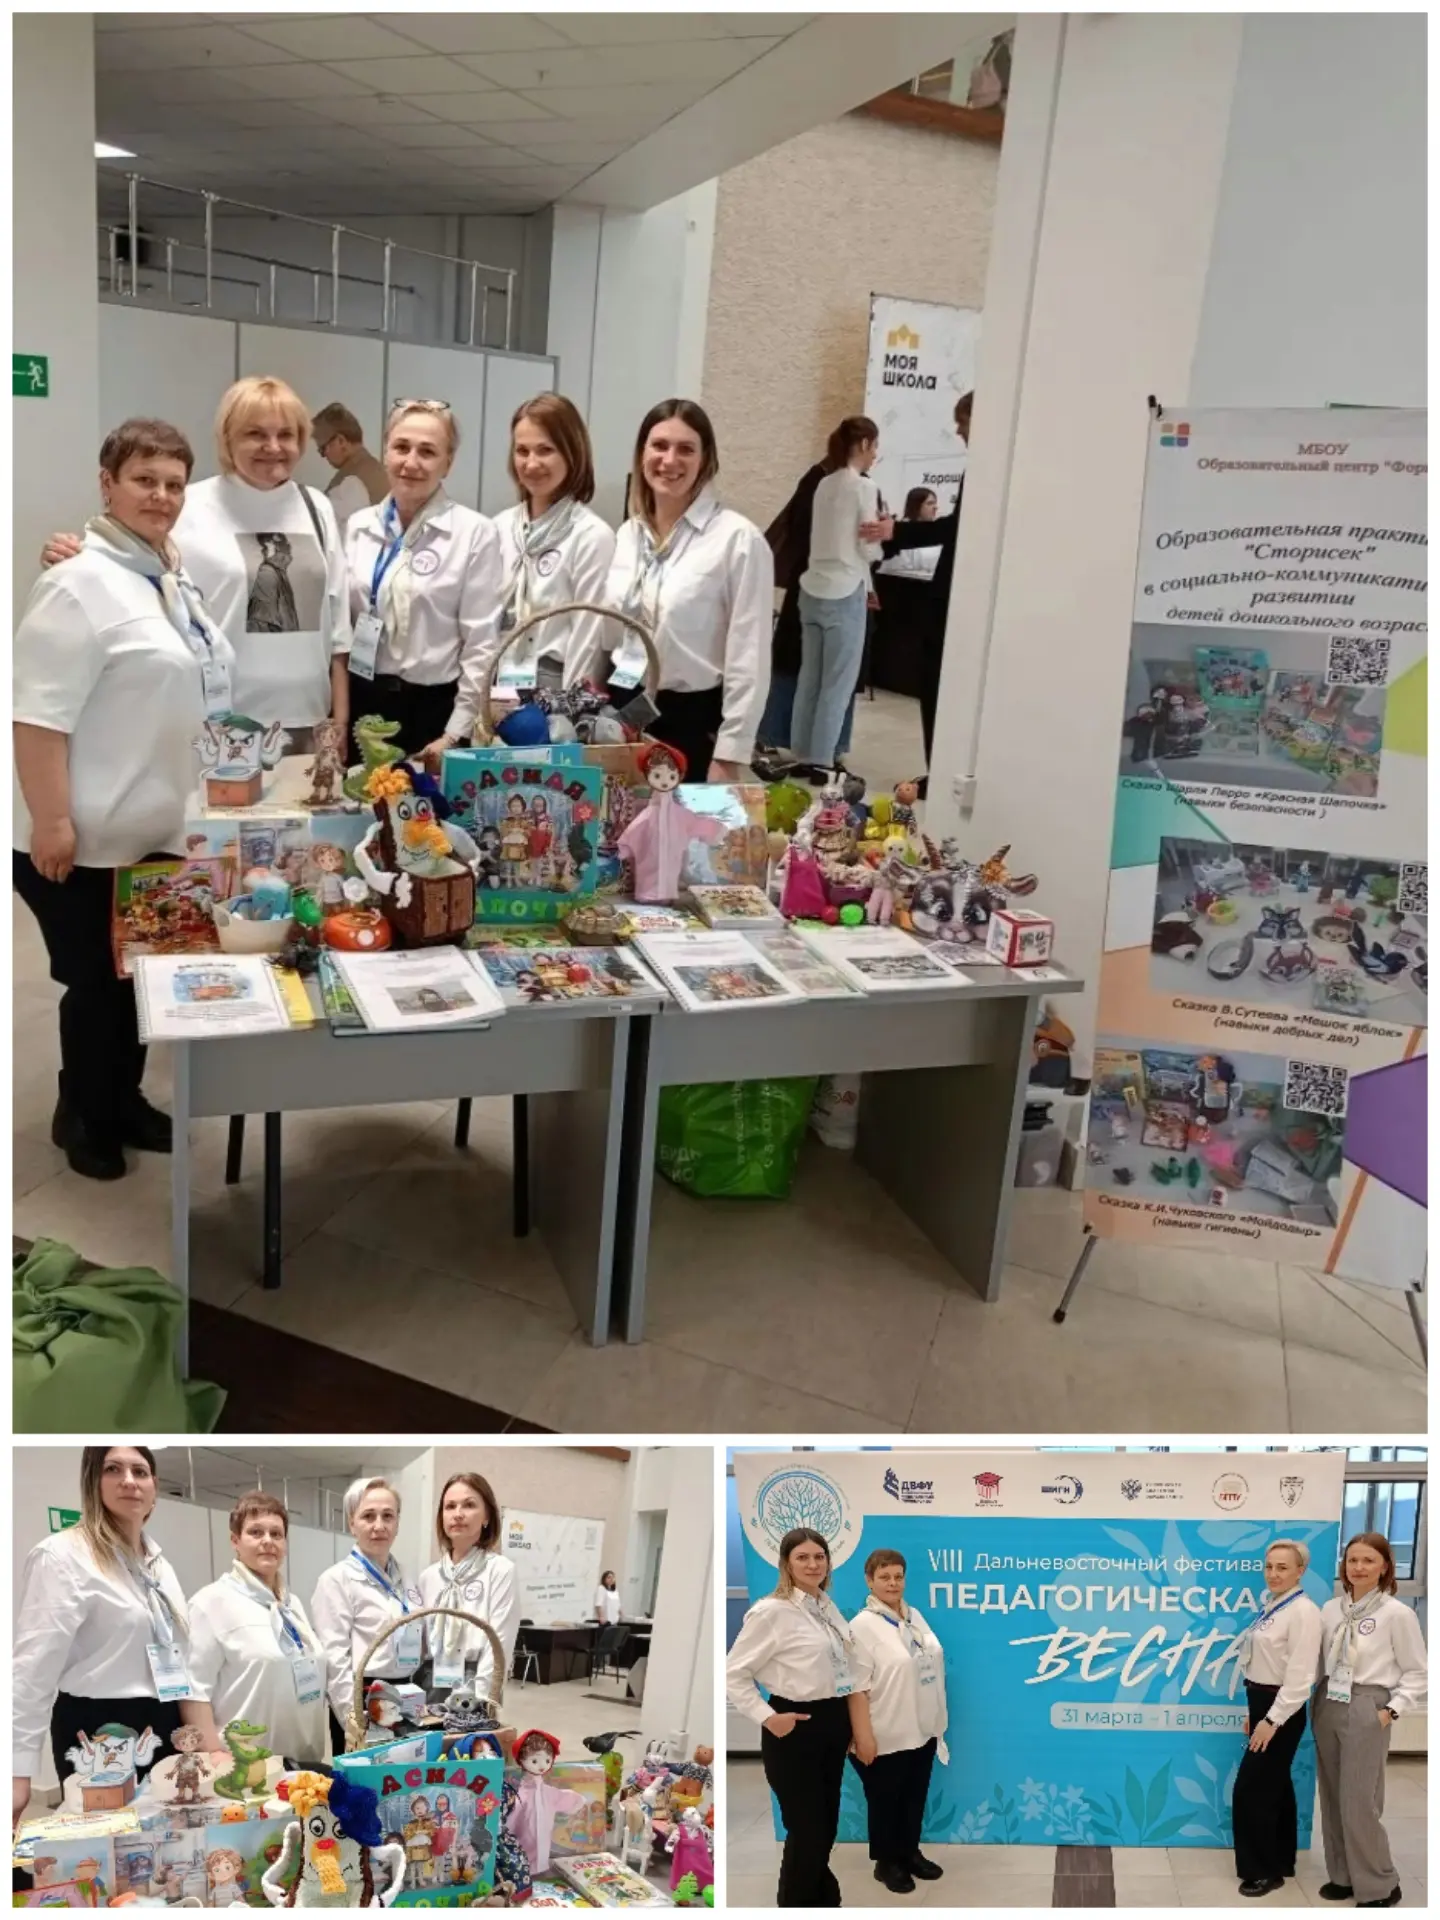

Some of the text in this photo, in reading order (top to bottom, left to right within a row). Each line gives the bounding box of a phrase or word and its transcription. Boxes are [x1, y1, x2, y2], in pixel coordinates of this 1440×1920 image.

[884, 354, 917, 370] МОЯ
[1297, 443, 1349, 456] МБОУ
[1197, 459, 1329, 474] Образовательный
[1334, 461, 1379, 475] центр
[922, 473, 961, 488] Хорош
[1156, 524, 1342, 550] Образовательная
[1245, 545, 1376, 562] "Сторисек"
[1250, 591, 1356, 608] развитии
[1166, 608, 1428, 634] детей дошкольного возрас
[1121, 779, 1162, 790] Сказка
[1211, 786, 1251, 799] Перро
[1229, 800, 1316, 817] безопасности
[1172, 998, 1218, 1013] Сказка
[1272, 1025, 1325, 1041] добрых
[1098, 1195, 1140, 1210] Сказка
[901, 1481, 933, 1491] ДВФУ
[928, 1549, 1264, 1577] VIII Дальневосточный фестива
[1061, 1708, 1079, 1723] 31
[1085, 1712, 1143, 1729] марта
[1164, 1710, 1170, 1725] 1
[381, 1767, 490, 1796] АСНАЯ
